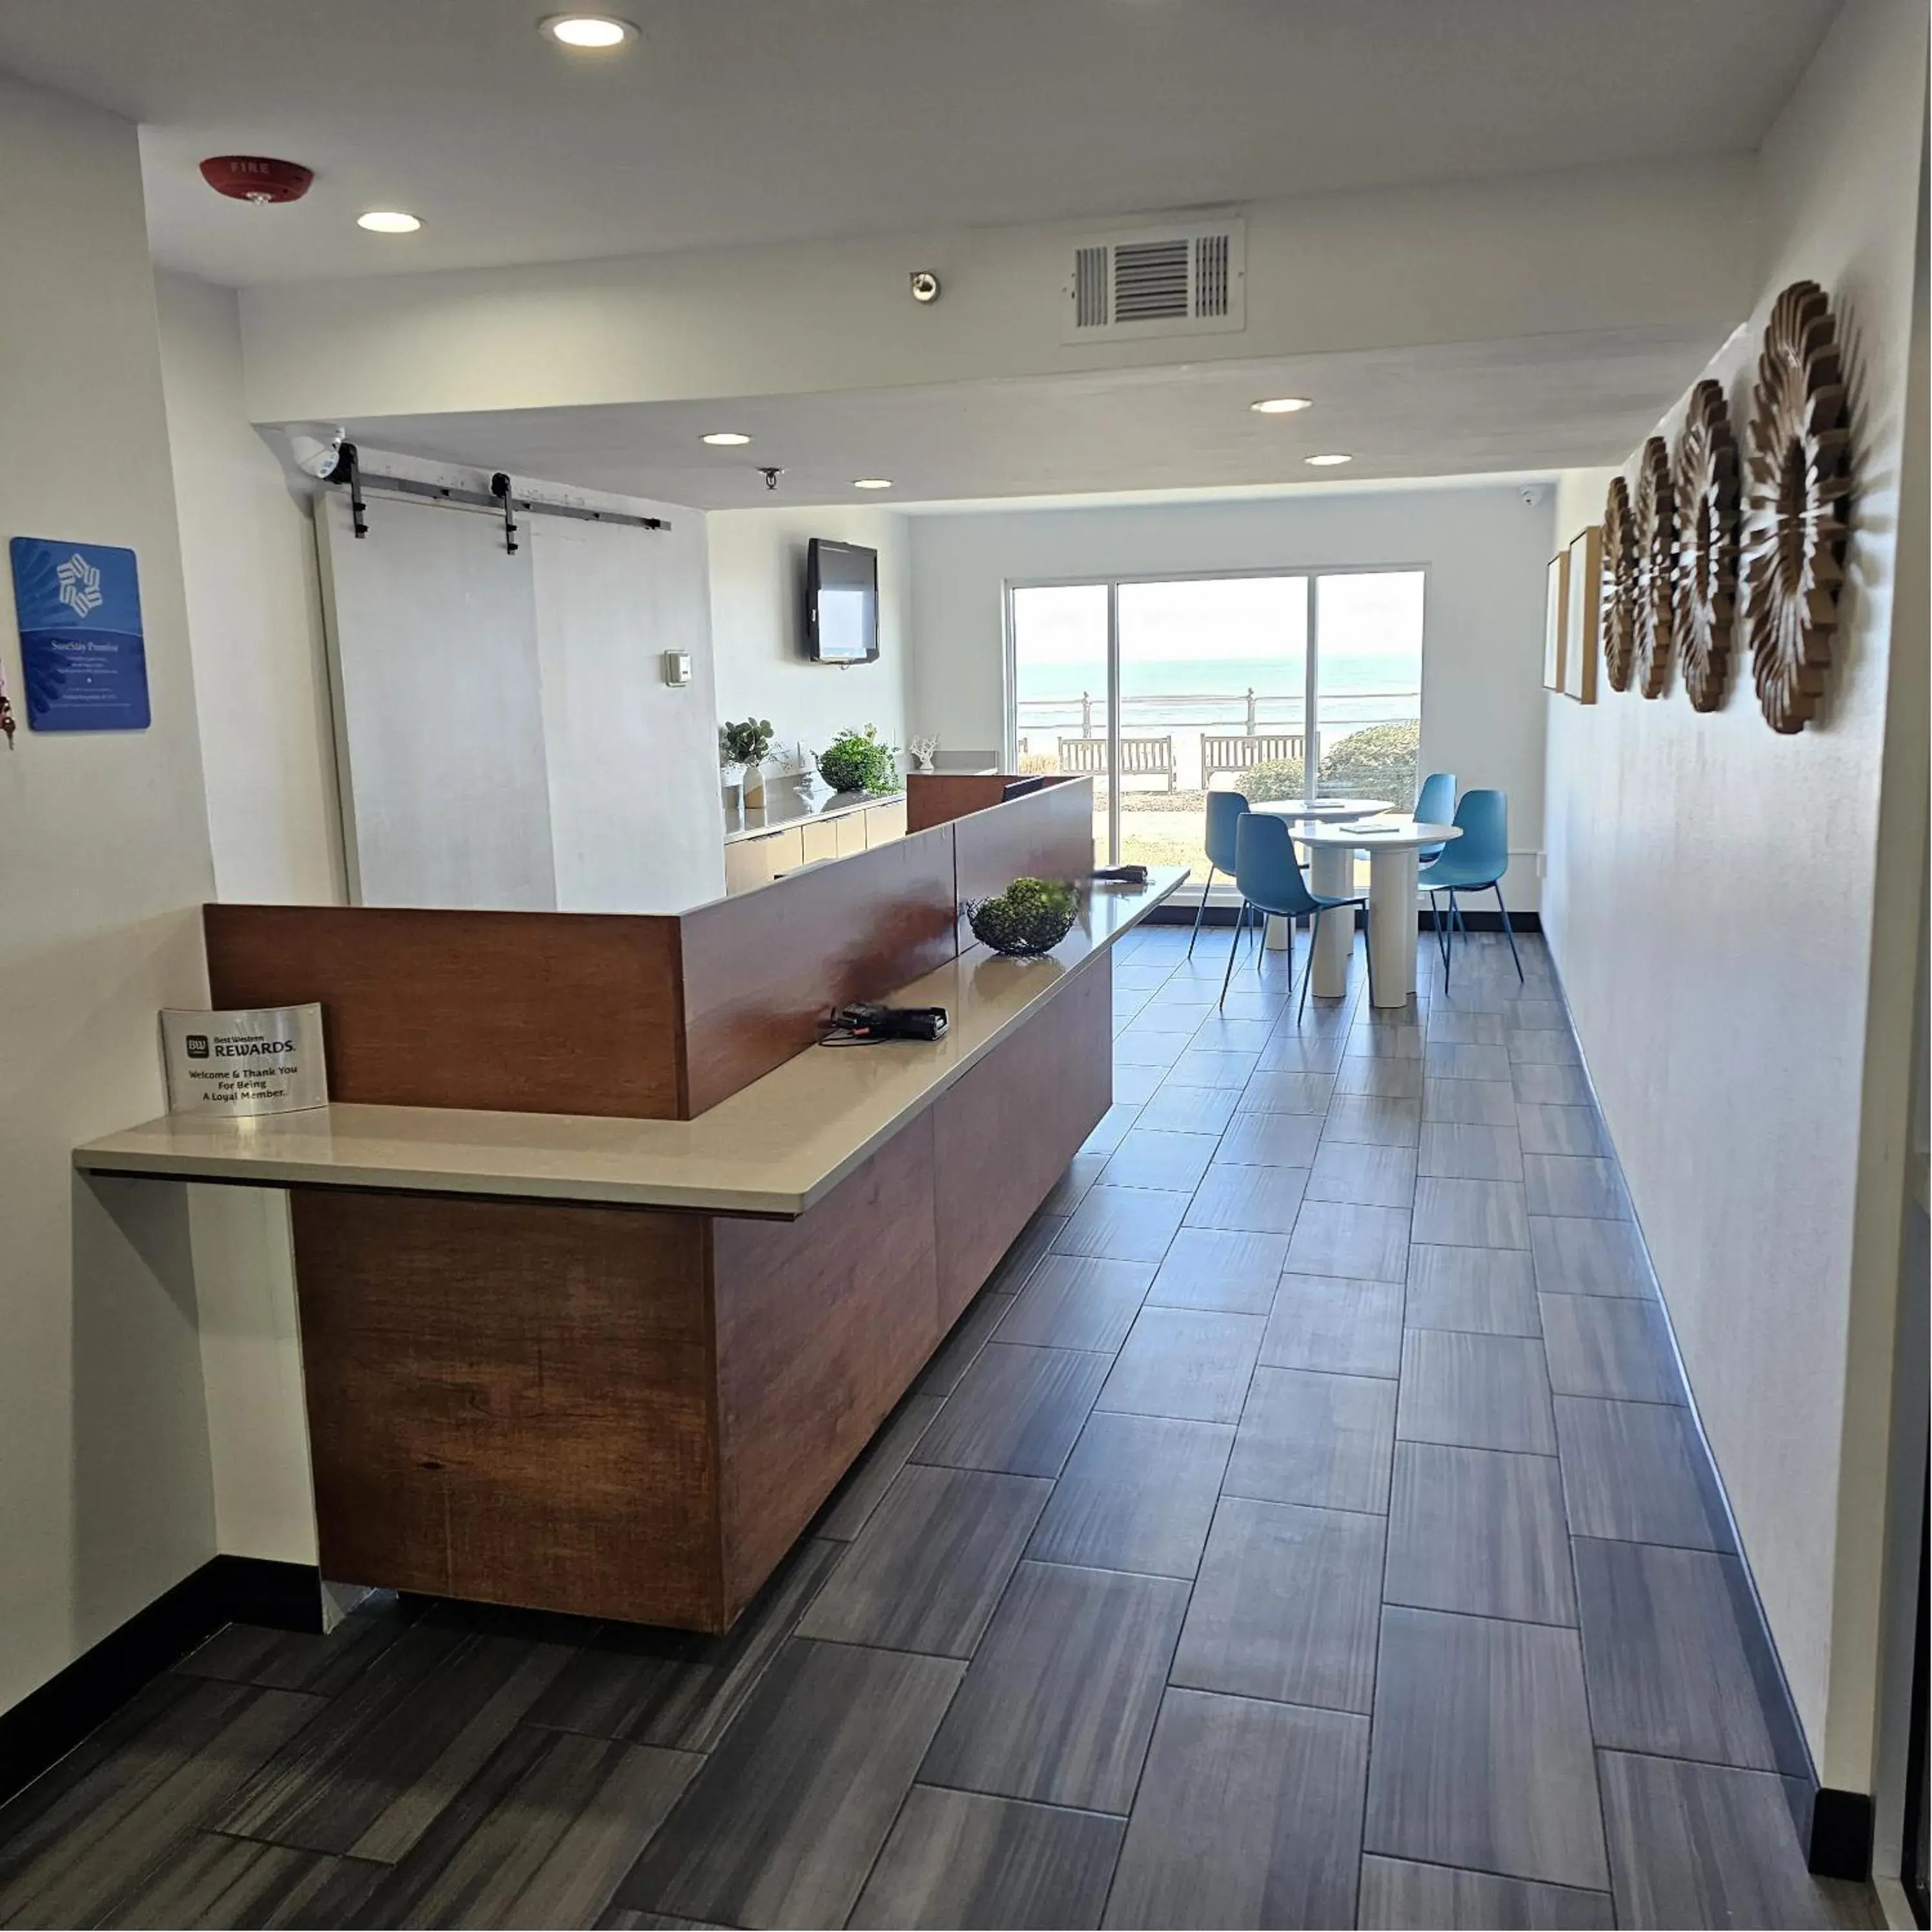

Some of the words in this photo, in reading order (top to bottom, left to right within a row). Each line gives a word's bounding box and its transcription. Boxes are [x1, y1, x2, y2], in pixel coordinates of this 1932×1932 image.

[230, 161, 270, 174] FIRE
[188, 1040, 206, 1051] BW
[188, 1070, 230, 1080] Welcome
[232, 1070, 240, 1079] &
[243, 1067, 276, 1078] Thank
[278, 1066, 298, 1075] You
[218, 1081, 235, 1090] For
[237, 1080, 267, 1089] Being
[203, 1092, 210, 1101] A
[212, 1091, 238, 1102] Loyal
